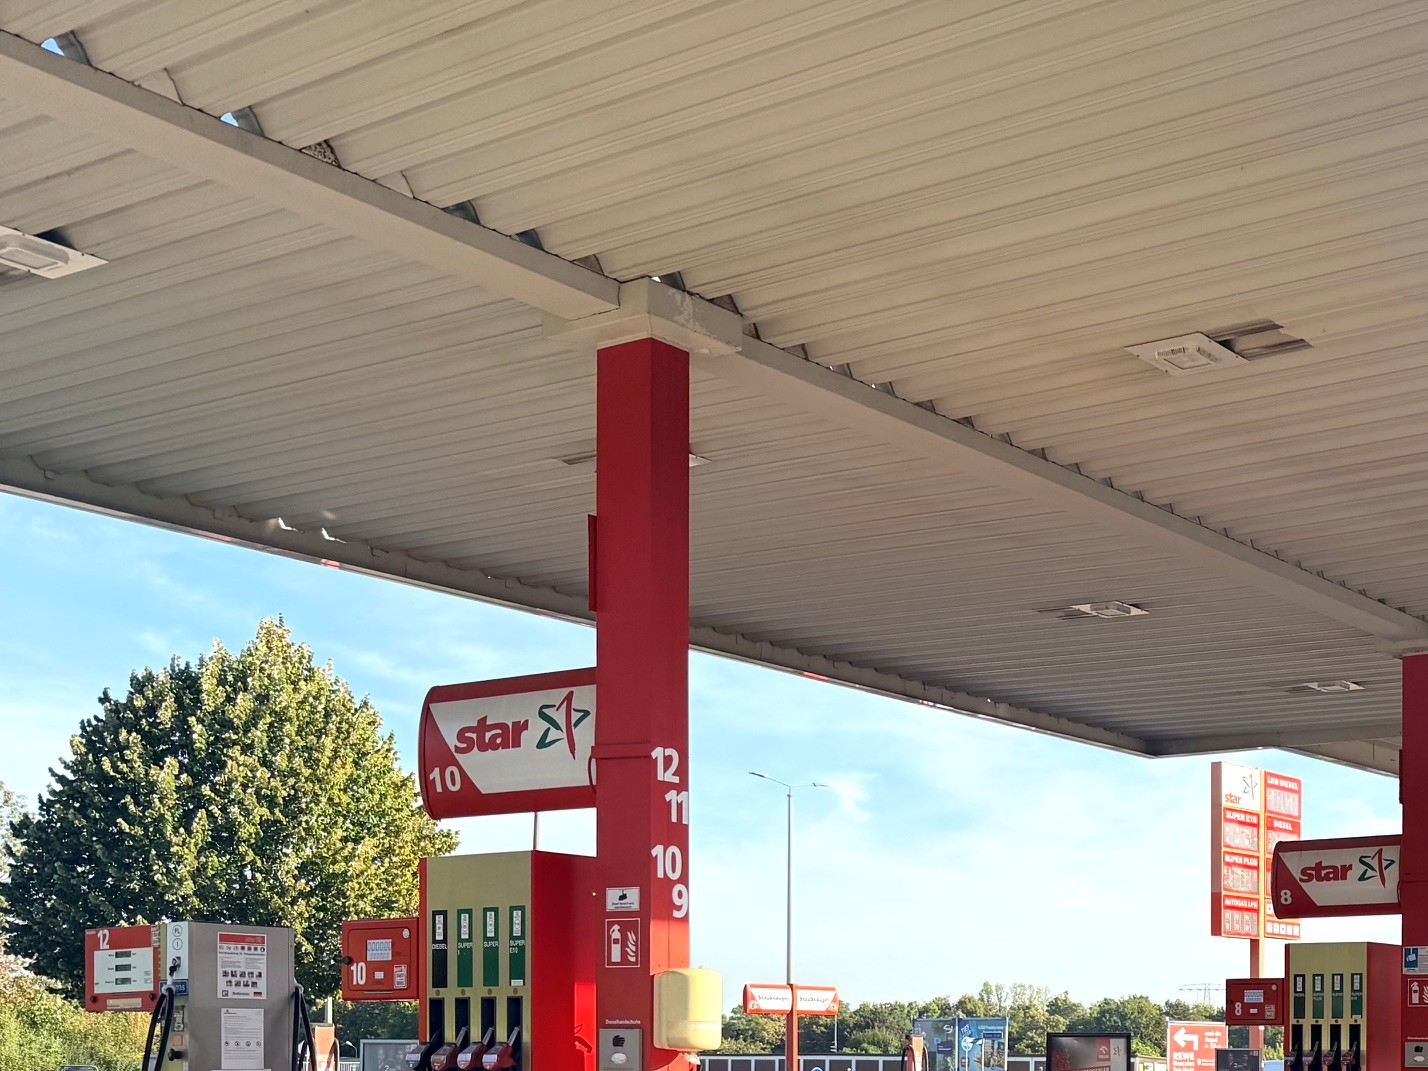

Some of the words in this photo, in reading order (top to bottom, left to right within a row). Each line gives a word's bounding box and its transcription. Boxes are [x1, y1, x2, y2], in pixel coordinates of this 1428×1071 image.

[454, 715, 529, 754] star
[650, 747, 680, 784] 12
[429, 765, 461, 793] 10
[1279, 779, 1299, 791] DIESEL
[1224, 792, 1241, 804] star
[664, 790, 688, 825] 11
[1225, 810, 1245, 821] SUPER
[1273, 819, 1293, 831] DIESEL
[651, 844, 682, 881] 10
[1224, 854, 1243, 864] SUPER
[1298, 860, 1352, 883] star
[672, 884, 688, 919] 9
[1280, 889, 1292, 905] 8
[97, 929, 110, 950] 12
[457, 941, 473, 949] SUPER
[483, 940, 499, 948] SUPER
[509, 939, 526, 947] SUPER
[350, 961, 367, 985] 10
[1234, 1002, 1242, 1016] 8
